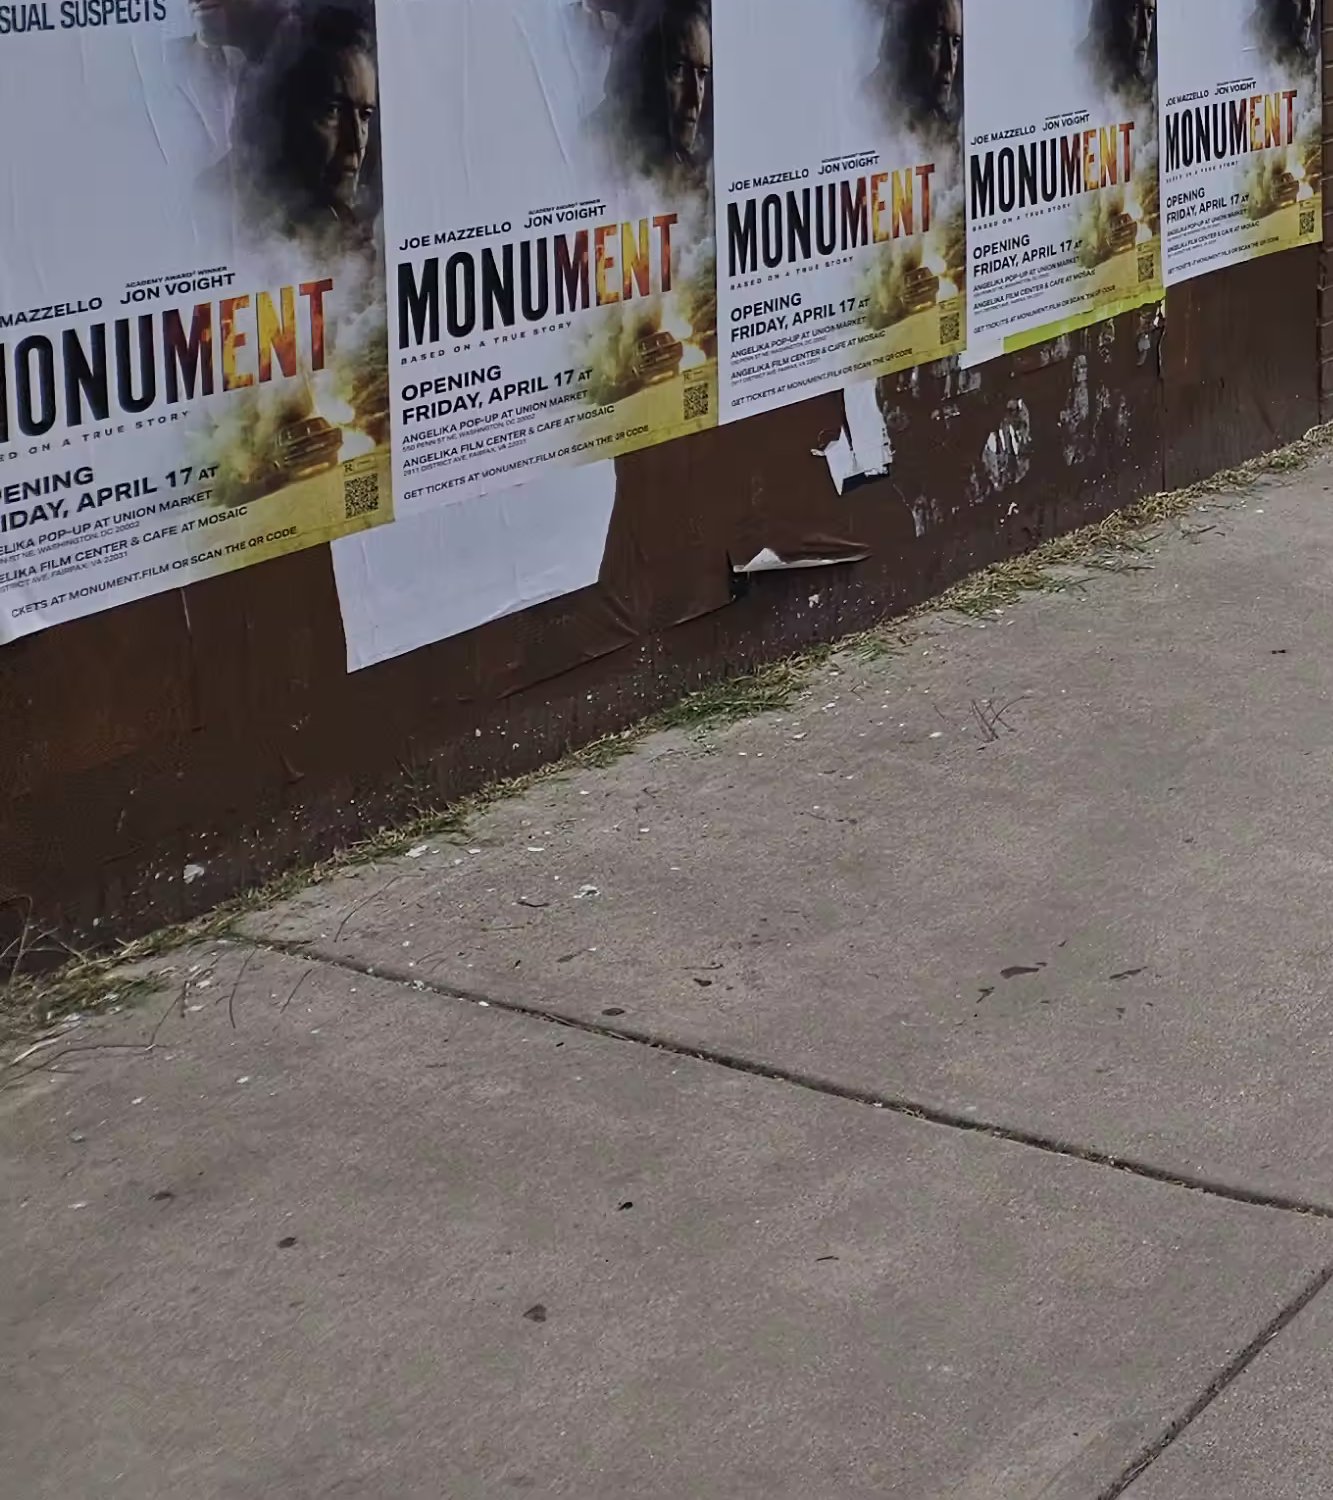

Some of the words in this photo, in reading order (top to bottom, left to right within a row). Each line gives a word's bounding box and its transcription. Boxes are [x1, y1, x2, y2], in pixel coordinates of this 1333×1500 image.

[1165, 90, 1297, 173] MONUMENT
[728, 181, 750, 192] JOE
[752, 168, 809, 187] MAZZELLO
[818, 163, 840, 176] JON
[842, 155, 880, 171] VOIGHT
[970, 121, 1135, 220] MONUMENT
[727, 163, 936, 278] MONUMENT
[1166, 187, 1205, 209] OPENING
[1166, 205, 1197, 225] FRIDAY,
[1198, 196, 1227, 214] APRIL
[1230, 193, 1239, 204] 17
[399, 235, 430, 251] JOE
[434, 221, 512, 246] MAZZELLO
[524, 214, 553, 229] JON
[556, 205, 606, 224] VOIGHT
[973, 234, 1030, 260] OPENING
[125, 277, 163, 288] ACADEMY
[197, 266, 227, 276] WINNER
[397, 213, 678, 350] MONUMENT
[973, 253, 1019, 278] FRIDAY,
[1022, 244, 1057, 265] APRIL
[1060, 239, 1072, 254] 17
[0, 297, 102, 328] MAZZELLO
[120, 288, 160, 305] JON
[165, 273, 236, 295] VOIGHT
[730, 292, 802, 322] OPENING
[731, 316, 789, 343] FRIDAY,
[792, 304, 836, 326] APRIL
[839, 297, 856, 314] 17
[0, 278, 333, 443] ONUMENT
[401, 350, 445, 366] BASED
[453, 343, 471, 354] ON
[494, 331, 526, 345] TRUE
[533, 321, 572, 336] STORY
[401, 365, 502, 402] OPENING
[402, 392, 484, 425] FRIDAY,
[488, 376, 549, 404] APRIL
[554, 369, 574, 388] 17
[578, 370, 593, 382] AT
[402, 424, 458, 445] ANGELIKA
[459, 412, 499, 430] POP-UP
[501, 408, 515, 418] AT
[515, 401, 547, 417] UNION
[548, 390, 589, 408] MARKET
[403, 448, 458, 469] ANGELIKA
[460, 441, 484, 455] FILM
[486, 428, 527, 448] CENTER
[527, 427, 535, 436] &
[536, 419, 563, 434] CAFE
[564, 414, 577, 425] AT
[577, 405, 616, 423] MOSAIC
[77, 477, 158, 513] APRIL
[165, 467, 193, 488] 17
[198, 465, 220, 481] AT
